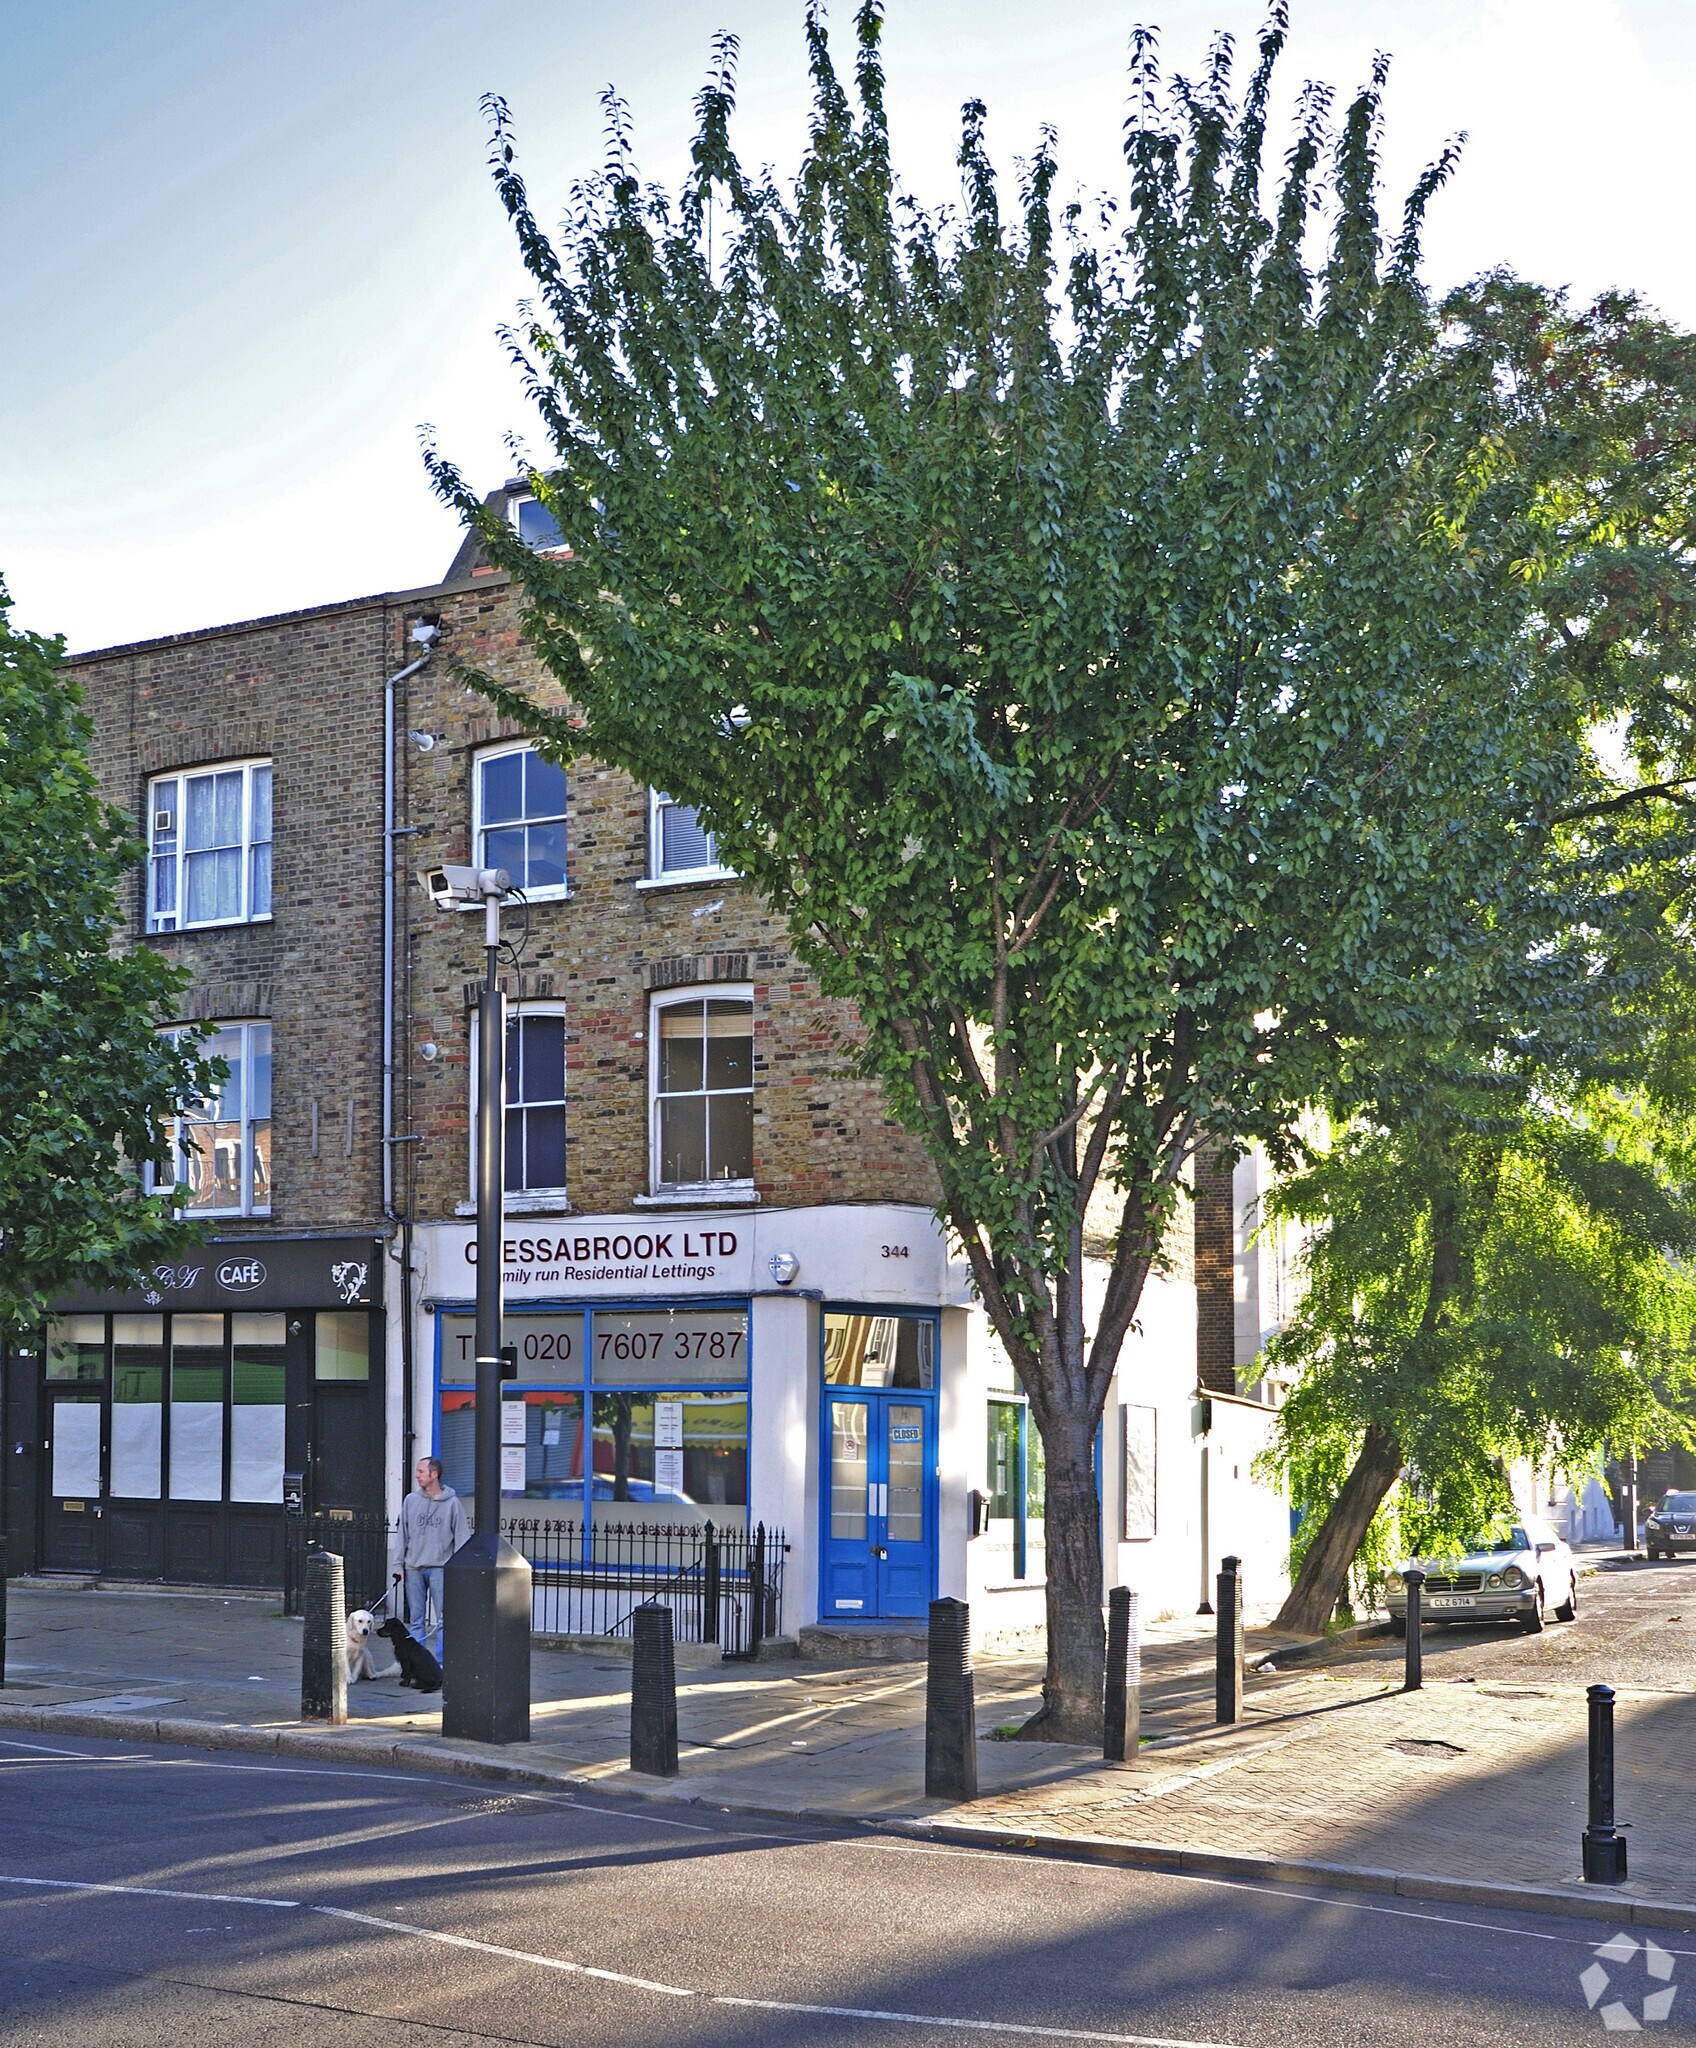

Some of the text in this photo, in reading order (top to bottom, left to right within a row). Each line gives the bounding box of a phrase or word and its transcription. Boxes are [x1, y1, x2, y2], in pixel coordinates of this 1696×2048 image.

[464, 1231, 738, 1265] CESSABROOK LTD
[881, 1244, 909, 1259] 344
[219, 1261, 260, 1284] CAFÉ
[502, 1263, 715, 1285] mily run Residential Lettings
[524, 1334, 571, 1360] 020
[598, 1333, 664, 1361] 7607
[674, 1331, 743, 1360] 3787
[893, 1429, 919, 1440] CLOSED
